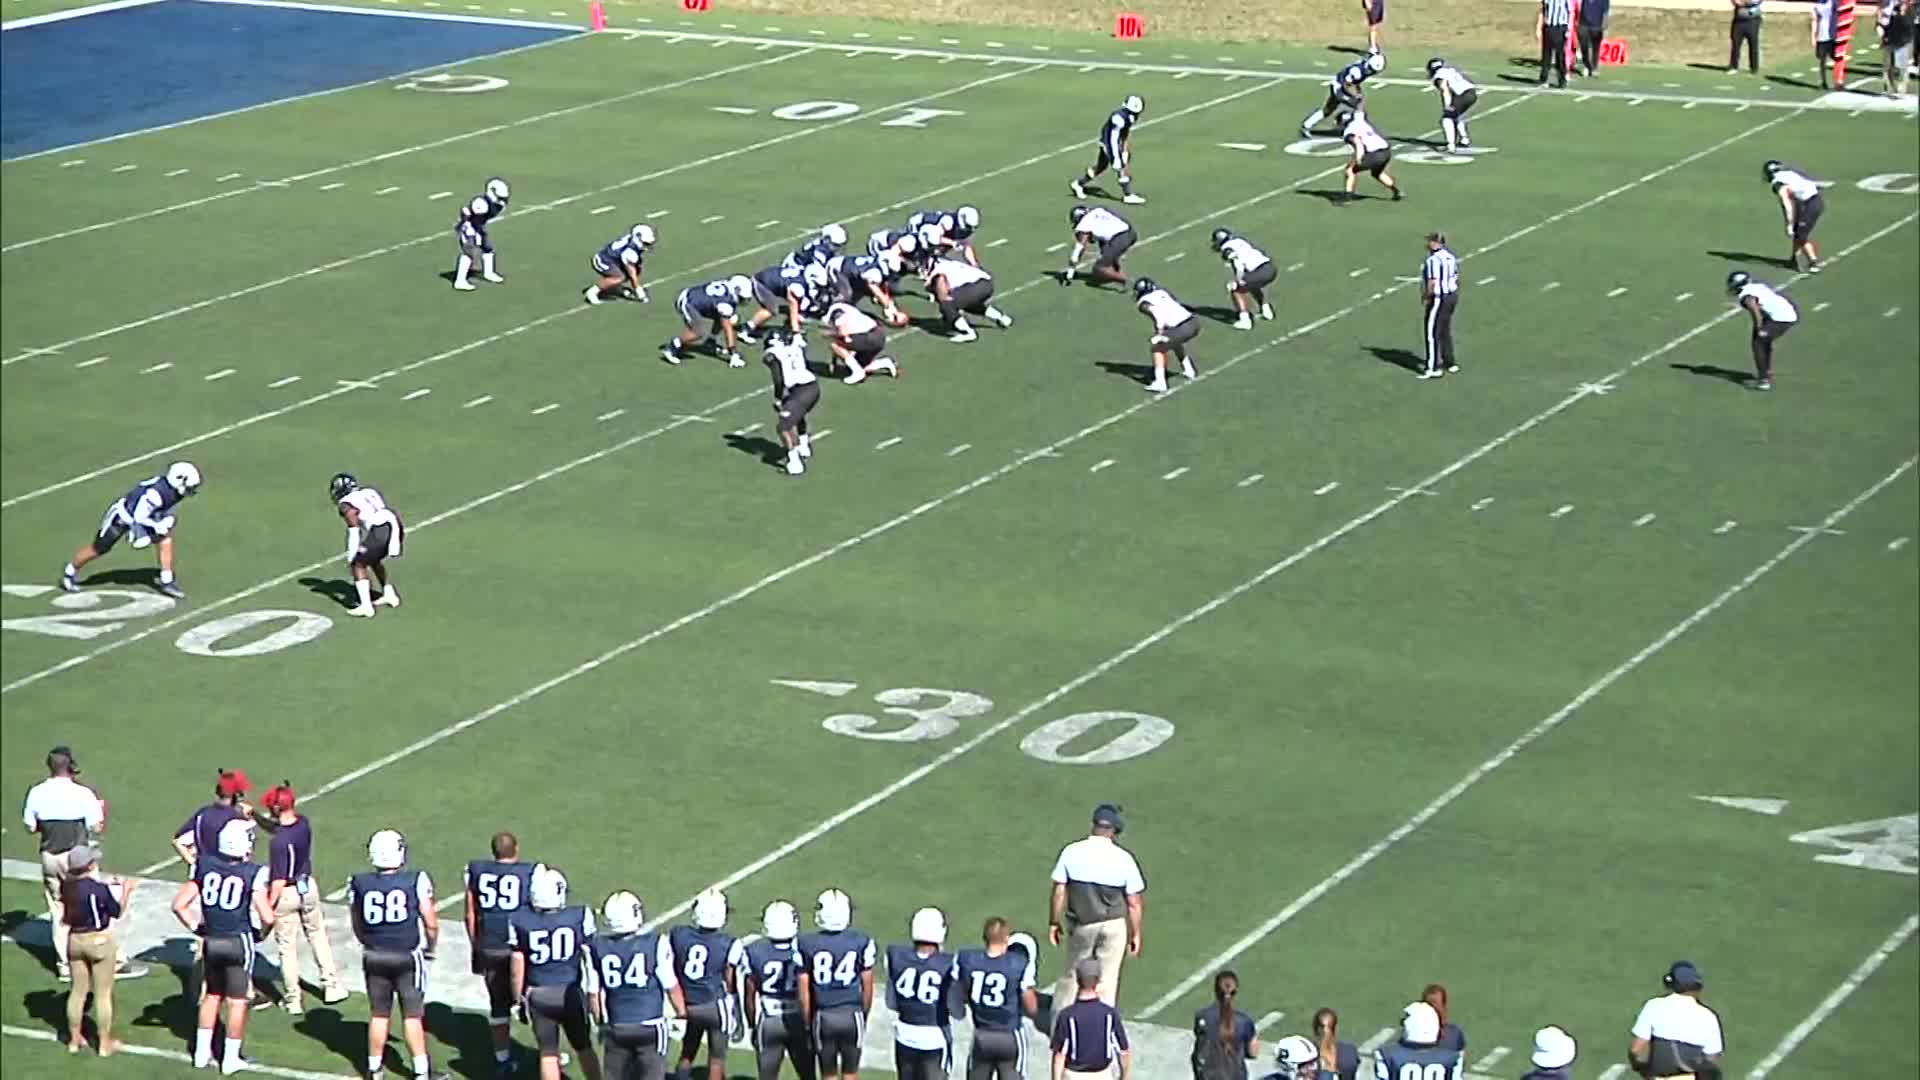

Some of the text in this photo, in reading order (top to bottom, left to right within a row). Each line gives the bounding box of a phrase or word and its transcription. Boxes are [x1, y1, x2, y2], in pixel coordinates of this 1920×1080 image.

[1120, 17, 1136, 37] 10
[1601, 43, 1620, 62] 20
[1, 590, 334, 656] 20
[822, 688, 1175, 764] 30
[201, 871, 244, 910] 80
[362, 890, 407, 926] 68
[478, 872, 521, 911] 59
[528, 927, 573, 965] 50
[683, 946, 707, 979] 8
[601, 953, 648, 988] 64
[813, 951, 857, 986] 84
[896, 968, 941, 1004] 46
[970, 970, 1005, 1007] 13
